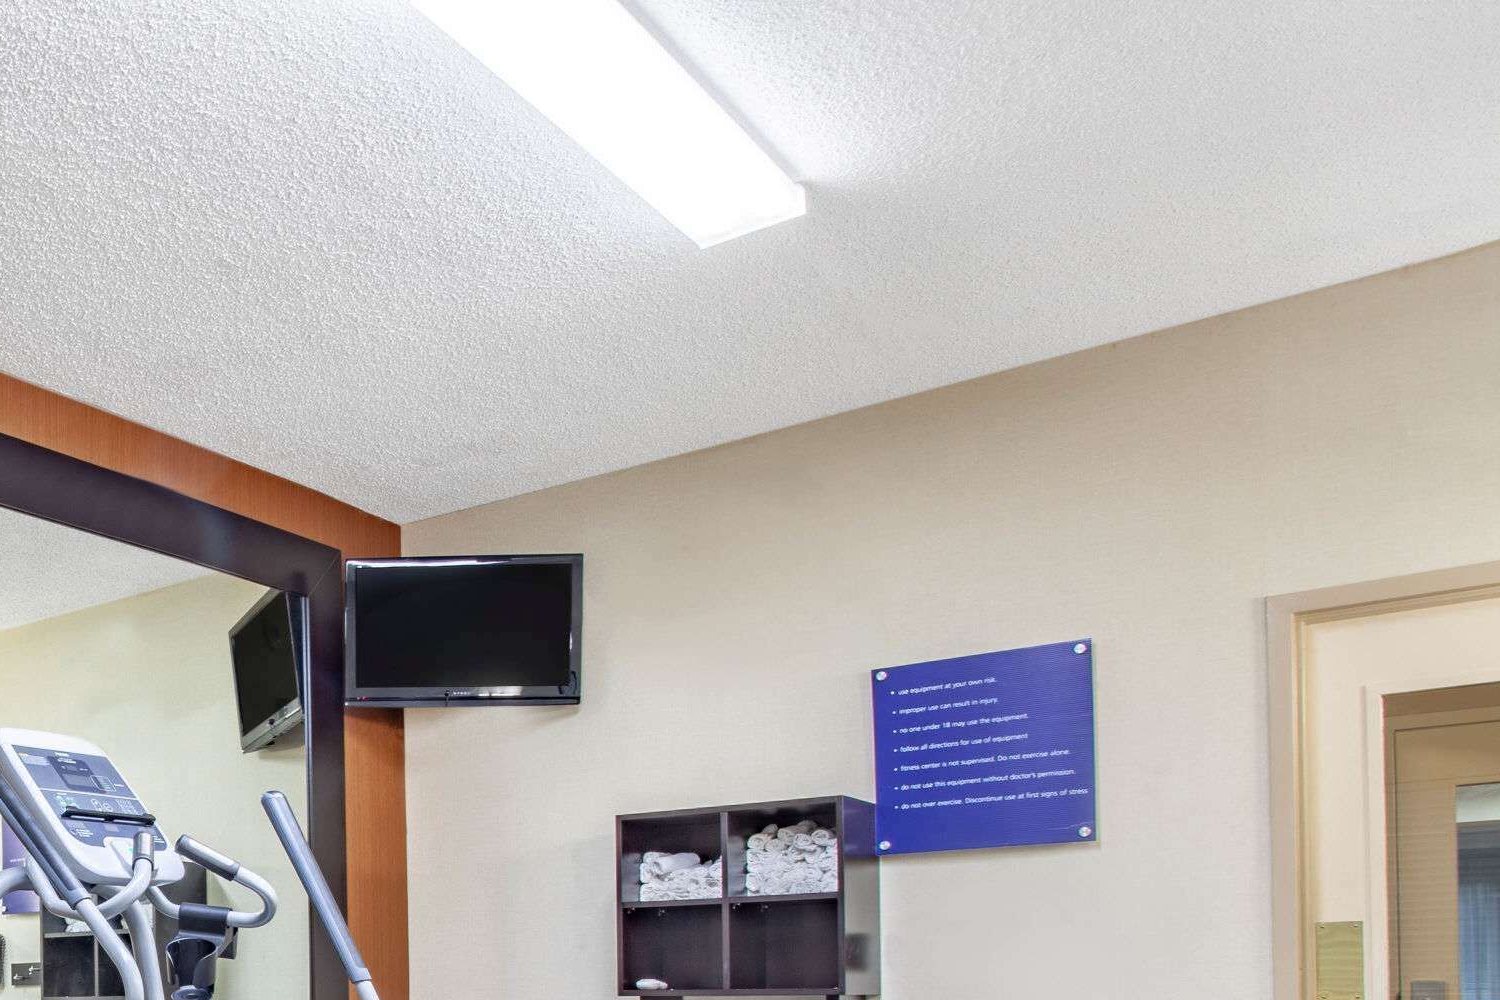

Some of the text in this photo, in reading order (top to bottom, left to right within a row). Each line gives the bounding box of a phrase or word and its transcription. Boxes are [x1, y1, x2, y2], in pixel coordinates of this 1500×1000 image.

[910, 684, 943, 694] equipment
[952, 681, 967, 689] your
[899, 706, 926, 716] improper
[940, 702, 952, 710] can
[952, 700, 970, 708] result
[922, 723, 940, 731] under
[900, 745, 919, 753] follow
[920, 743, 928, 751] all
[929, 740, 959, 750] directions
[960, 738, 969, 746] for
[983, 736, 991, 744] of
[900, 764, 920, 772] fitness
[997, 754, 1008, 762] Do
[1021, 751, 1049, 759] exercise
[946, 777, 981, 788] equipment
[982, 774, 1008, 783] without
[964, 795, 1003, 804] Discontinue
[1004, 793, 1017, 801] use
[1059, 788, 1067, 796] of
